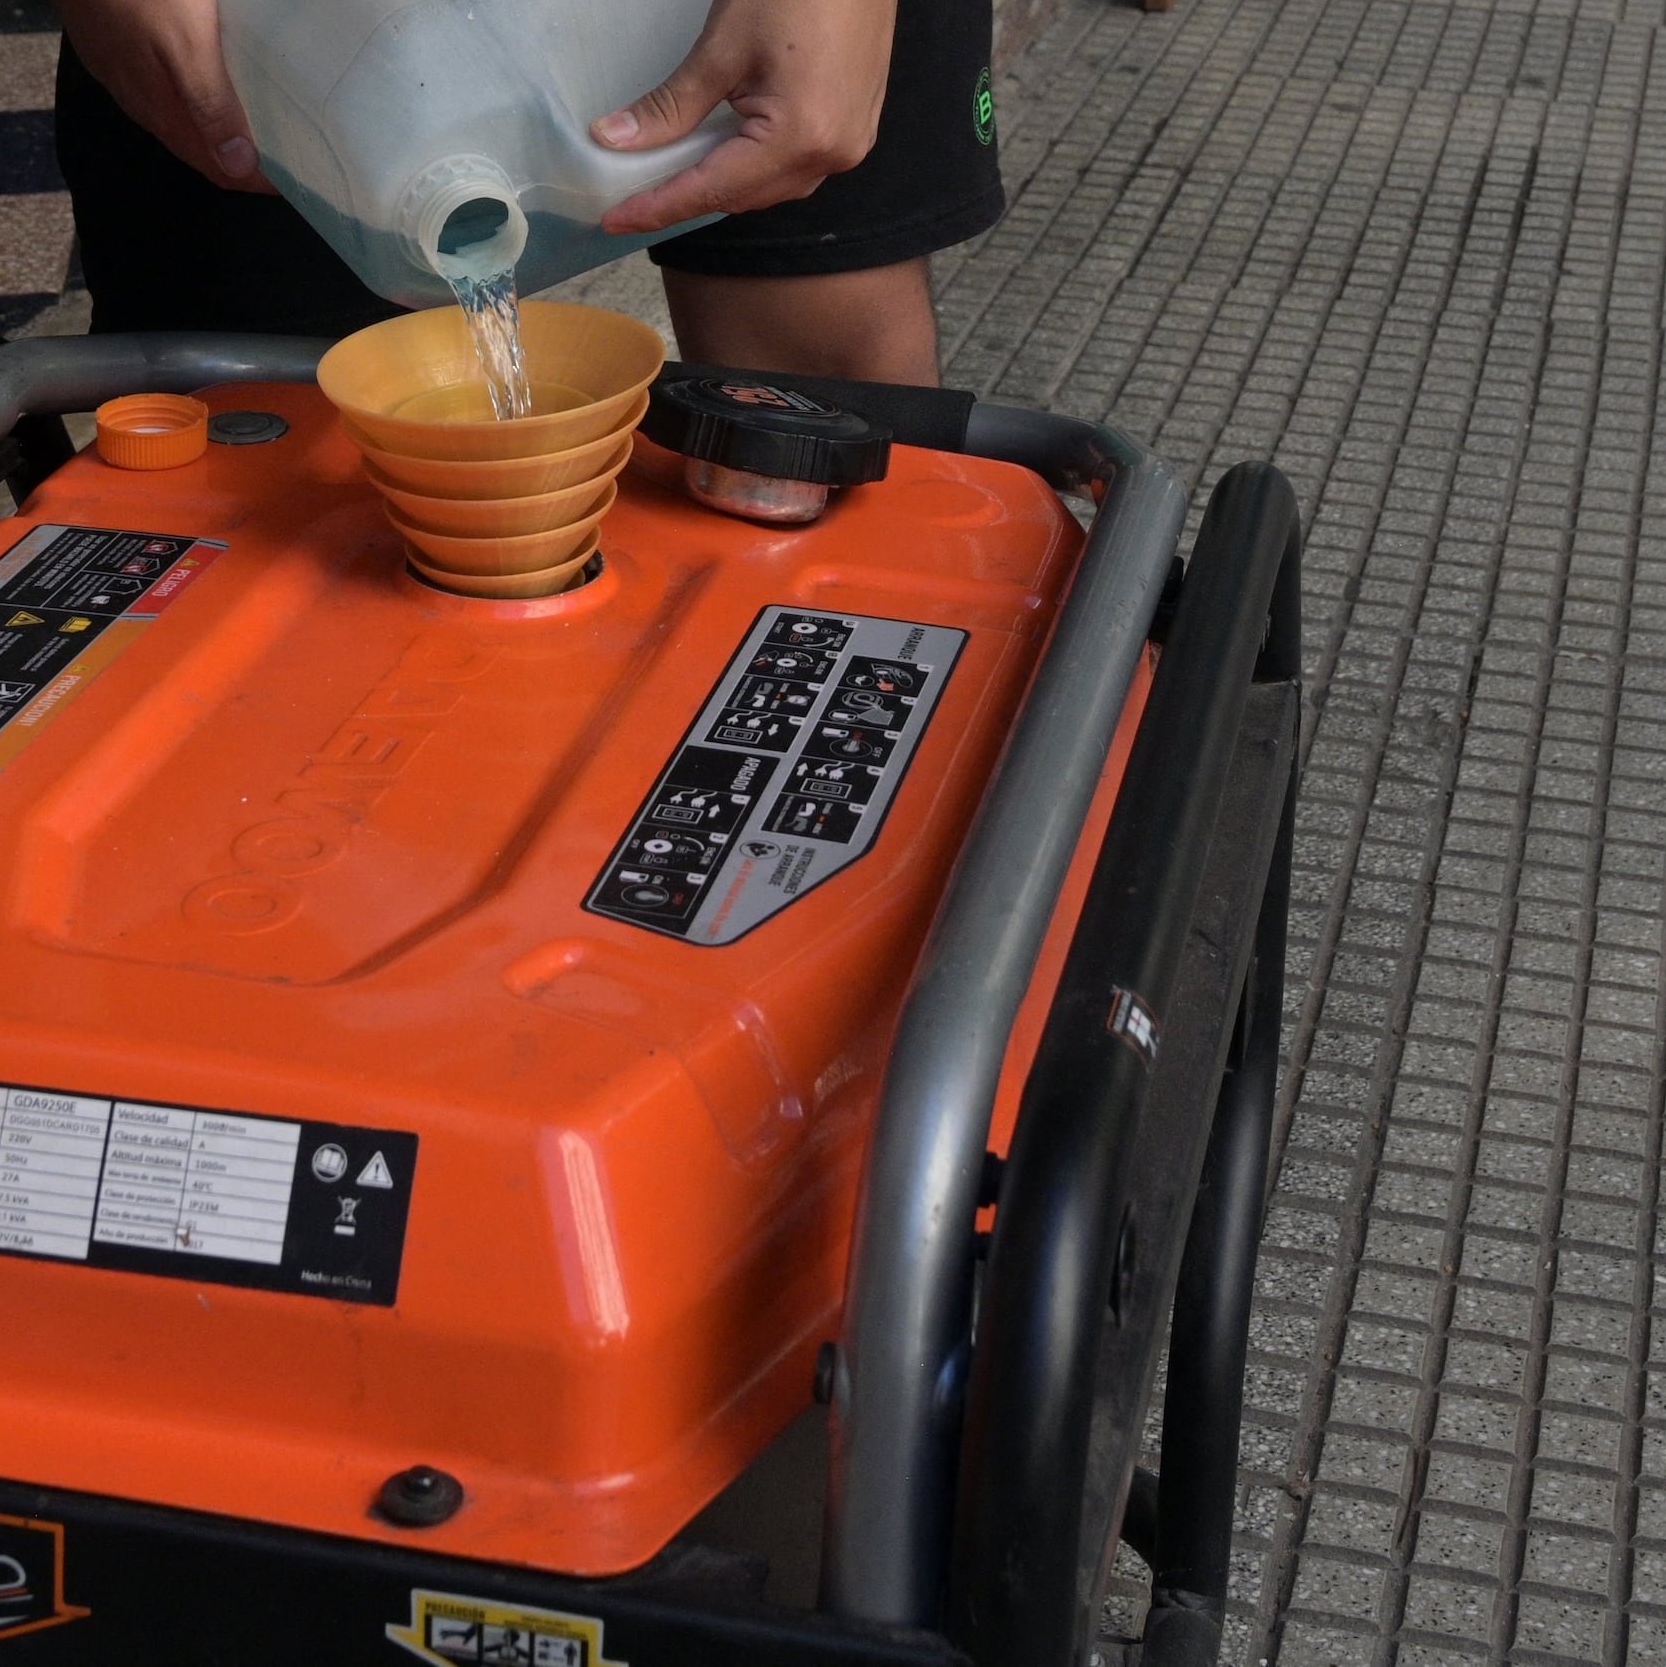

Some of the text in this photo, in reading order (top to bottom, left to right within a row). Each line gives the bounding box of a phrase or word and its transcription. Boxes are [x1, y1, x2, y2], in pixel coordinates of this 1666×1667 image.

[979, 90, 992, 125] B
[152, 569, 192, 597] PELIGRO
[898, 626, 926, 661] ARRANQUE
[730, 756, 762, 791] APAGADO
[14, 1095, 77, 1114] GDA9250E
[118, 1108, 169, 1125] Velocidad
[114, 1130, 189, 1148] Clase de calidad
[1, 1173, 20, 1183] 27A
